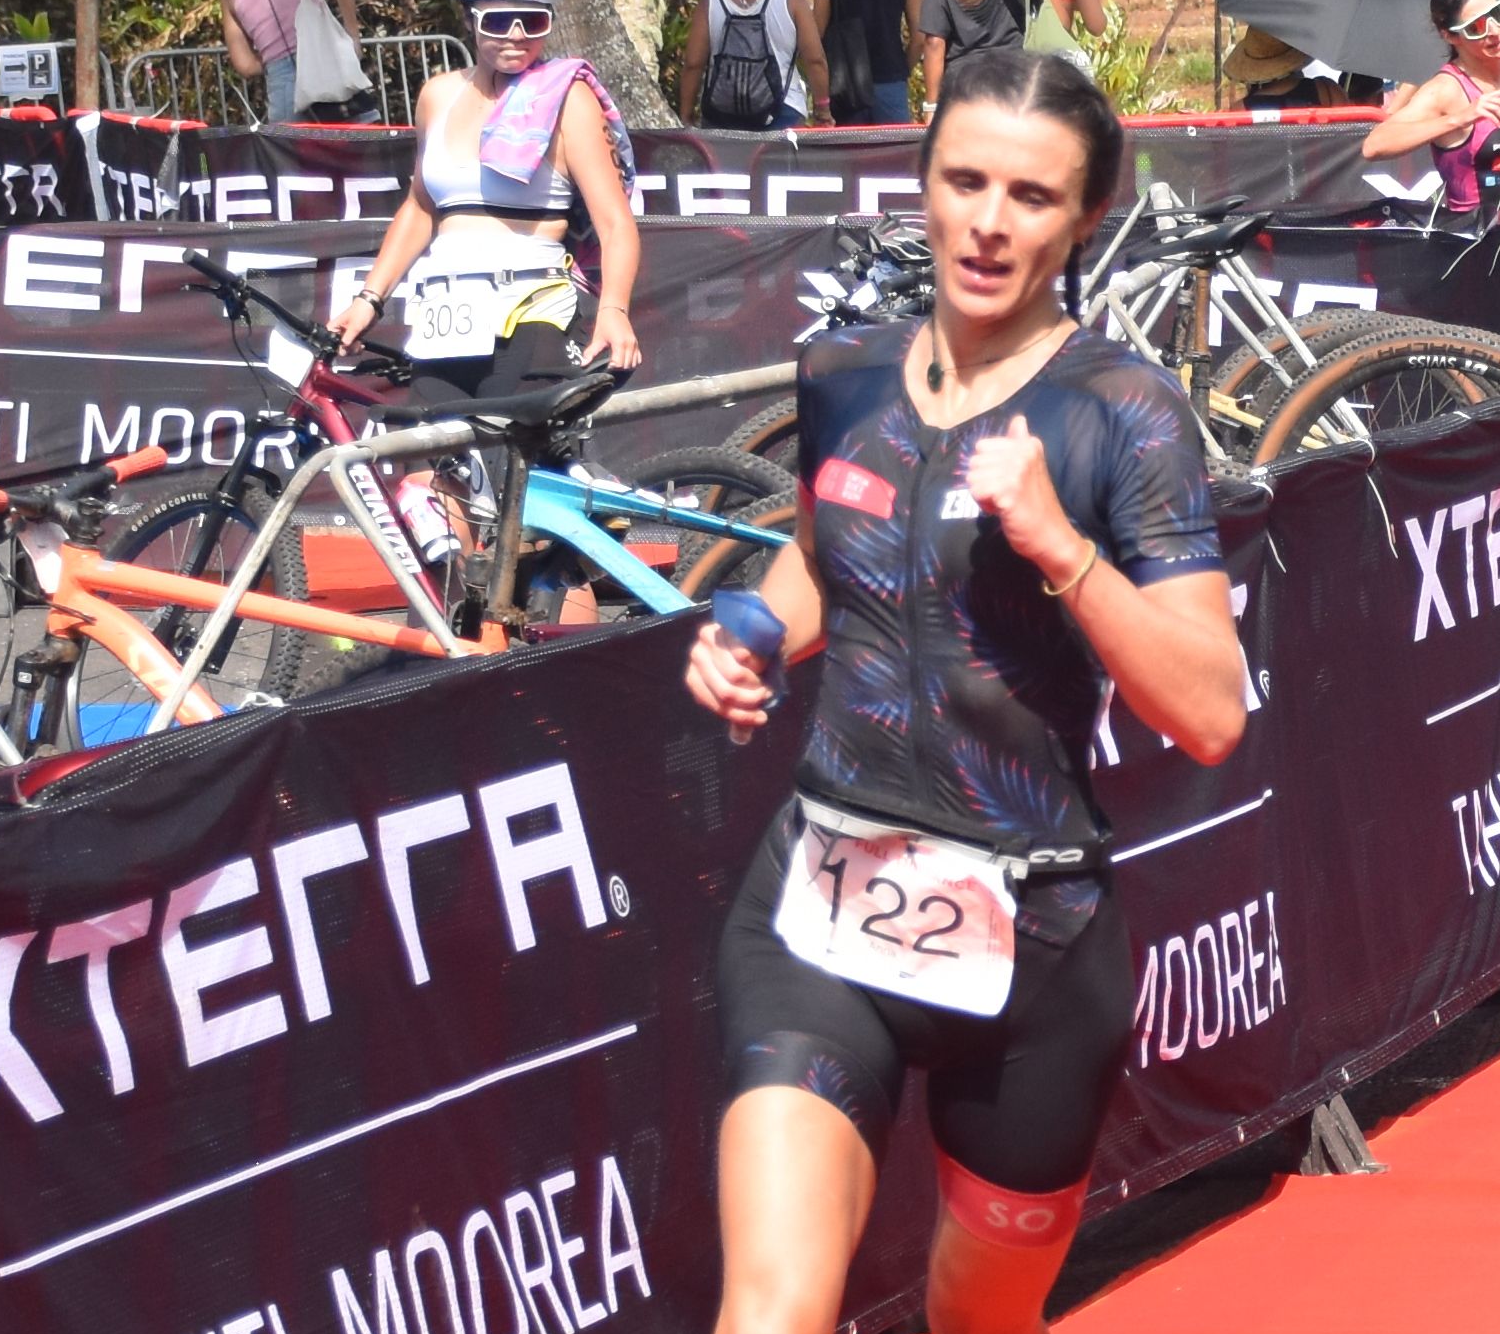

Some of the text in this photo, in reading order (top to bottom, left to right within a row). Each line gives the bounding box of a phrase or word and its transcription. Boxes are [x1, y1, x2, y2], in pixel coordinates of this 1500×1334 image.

[422, 303, 474, 339] 303
[1408, 355, 1457, 369] SWISS
[820, 858, 964, 959] 122
